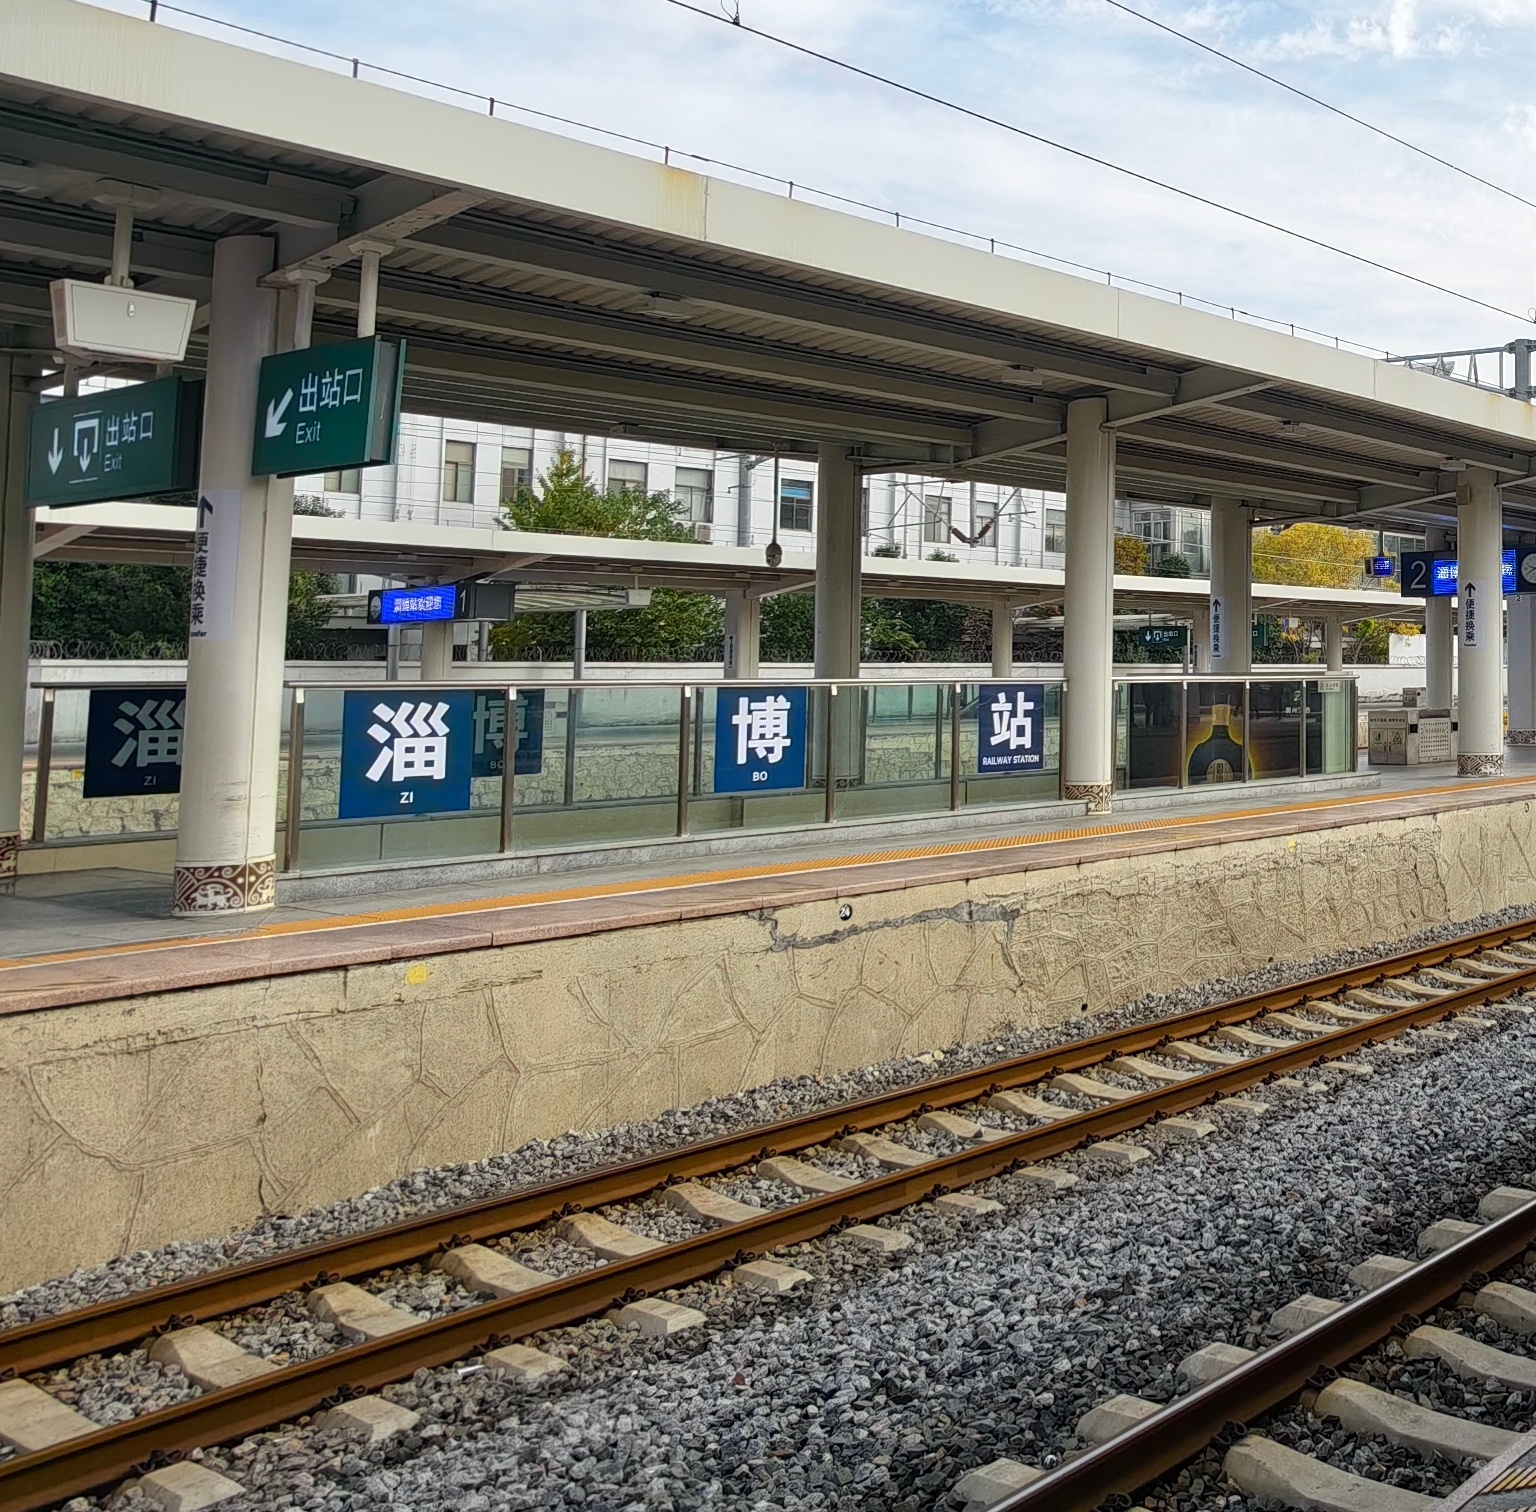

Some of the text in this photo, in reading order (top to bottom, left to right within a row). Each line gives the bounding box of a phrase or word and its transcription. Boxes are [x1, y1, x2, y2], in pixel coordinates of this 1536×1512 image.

[299, 367, 363, 413] 出站口
[105, 410, 154, 447] 出站口
[295, 421, 321, 445] Exit
[104, 453, 122, 472] Exit
[1410, 560, 1427, 589] 2
[460, 589, 467, 613] 1
[1465, 598, 1475, 642] 便捷换乘
[111, 699, 184, 768] 淄
[473, 693, 528, 755] 博
[732, 695, 791, 765] 博
[990, 691, 1034, 750] 站
[365, 701, 450, 782] 淄
[752, 771, 768, 782] BO
[982, 754, 1040, 766] RAILWAY STATION
[143, 775, 157, 786] ZI
[400, 791, 414, 804] ZI
